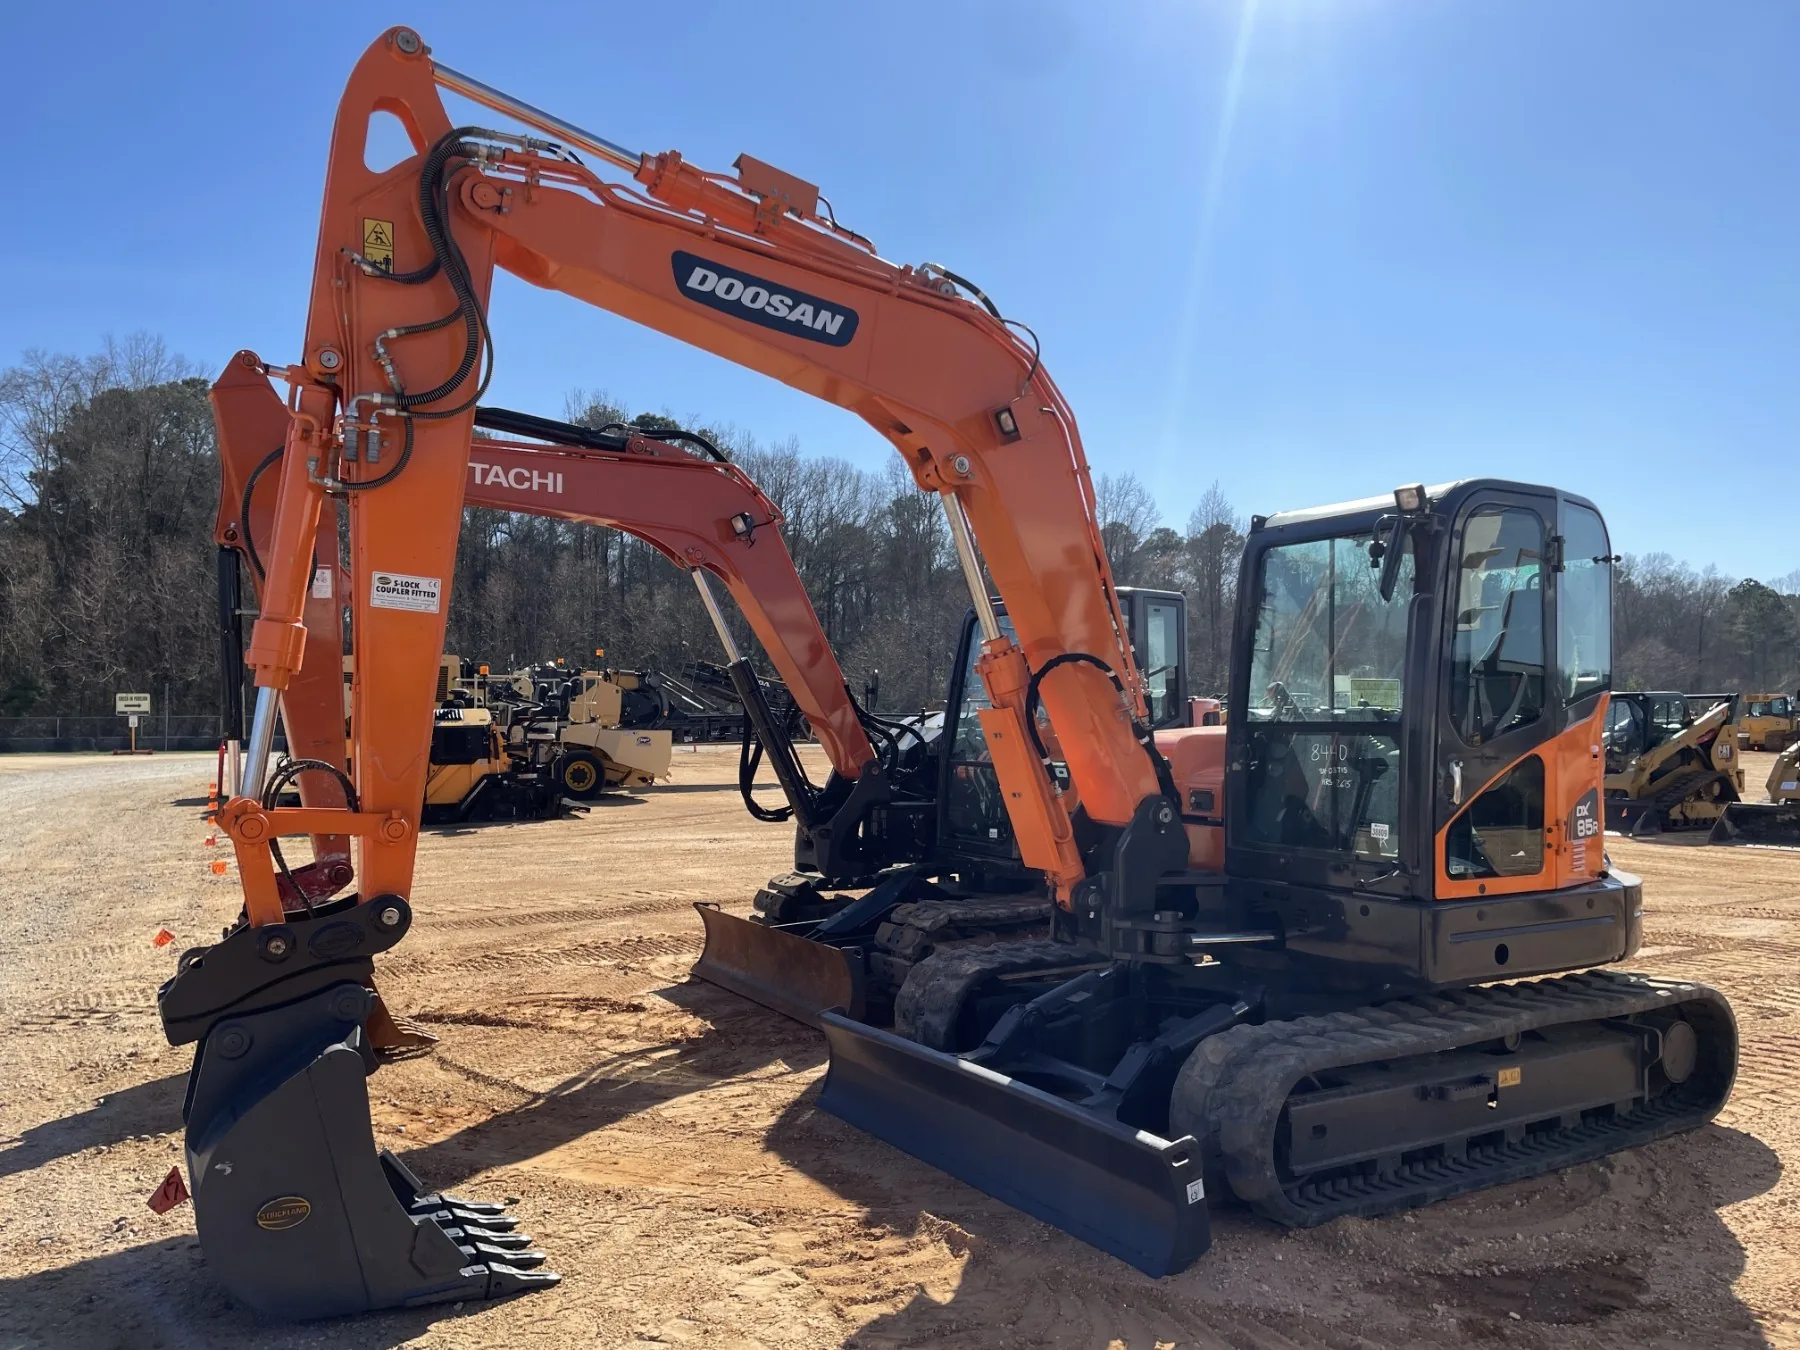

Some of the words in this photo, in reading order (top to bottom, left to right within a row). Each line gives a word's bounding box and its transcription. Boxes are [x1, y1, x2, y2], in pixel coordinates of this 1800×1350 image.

[686, 266, 845, 336] DOOSAN
[376, 586, 410, 596] COUPLER
[411, 590, 436, 598] FITTED
[394, 580, 420, 589] S-LOCK
[1718, 744, 1731, 759] CAT
[1576, 801, 1591, 817] DX
